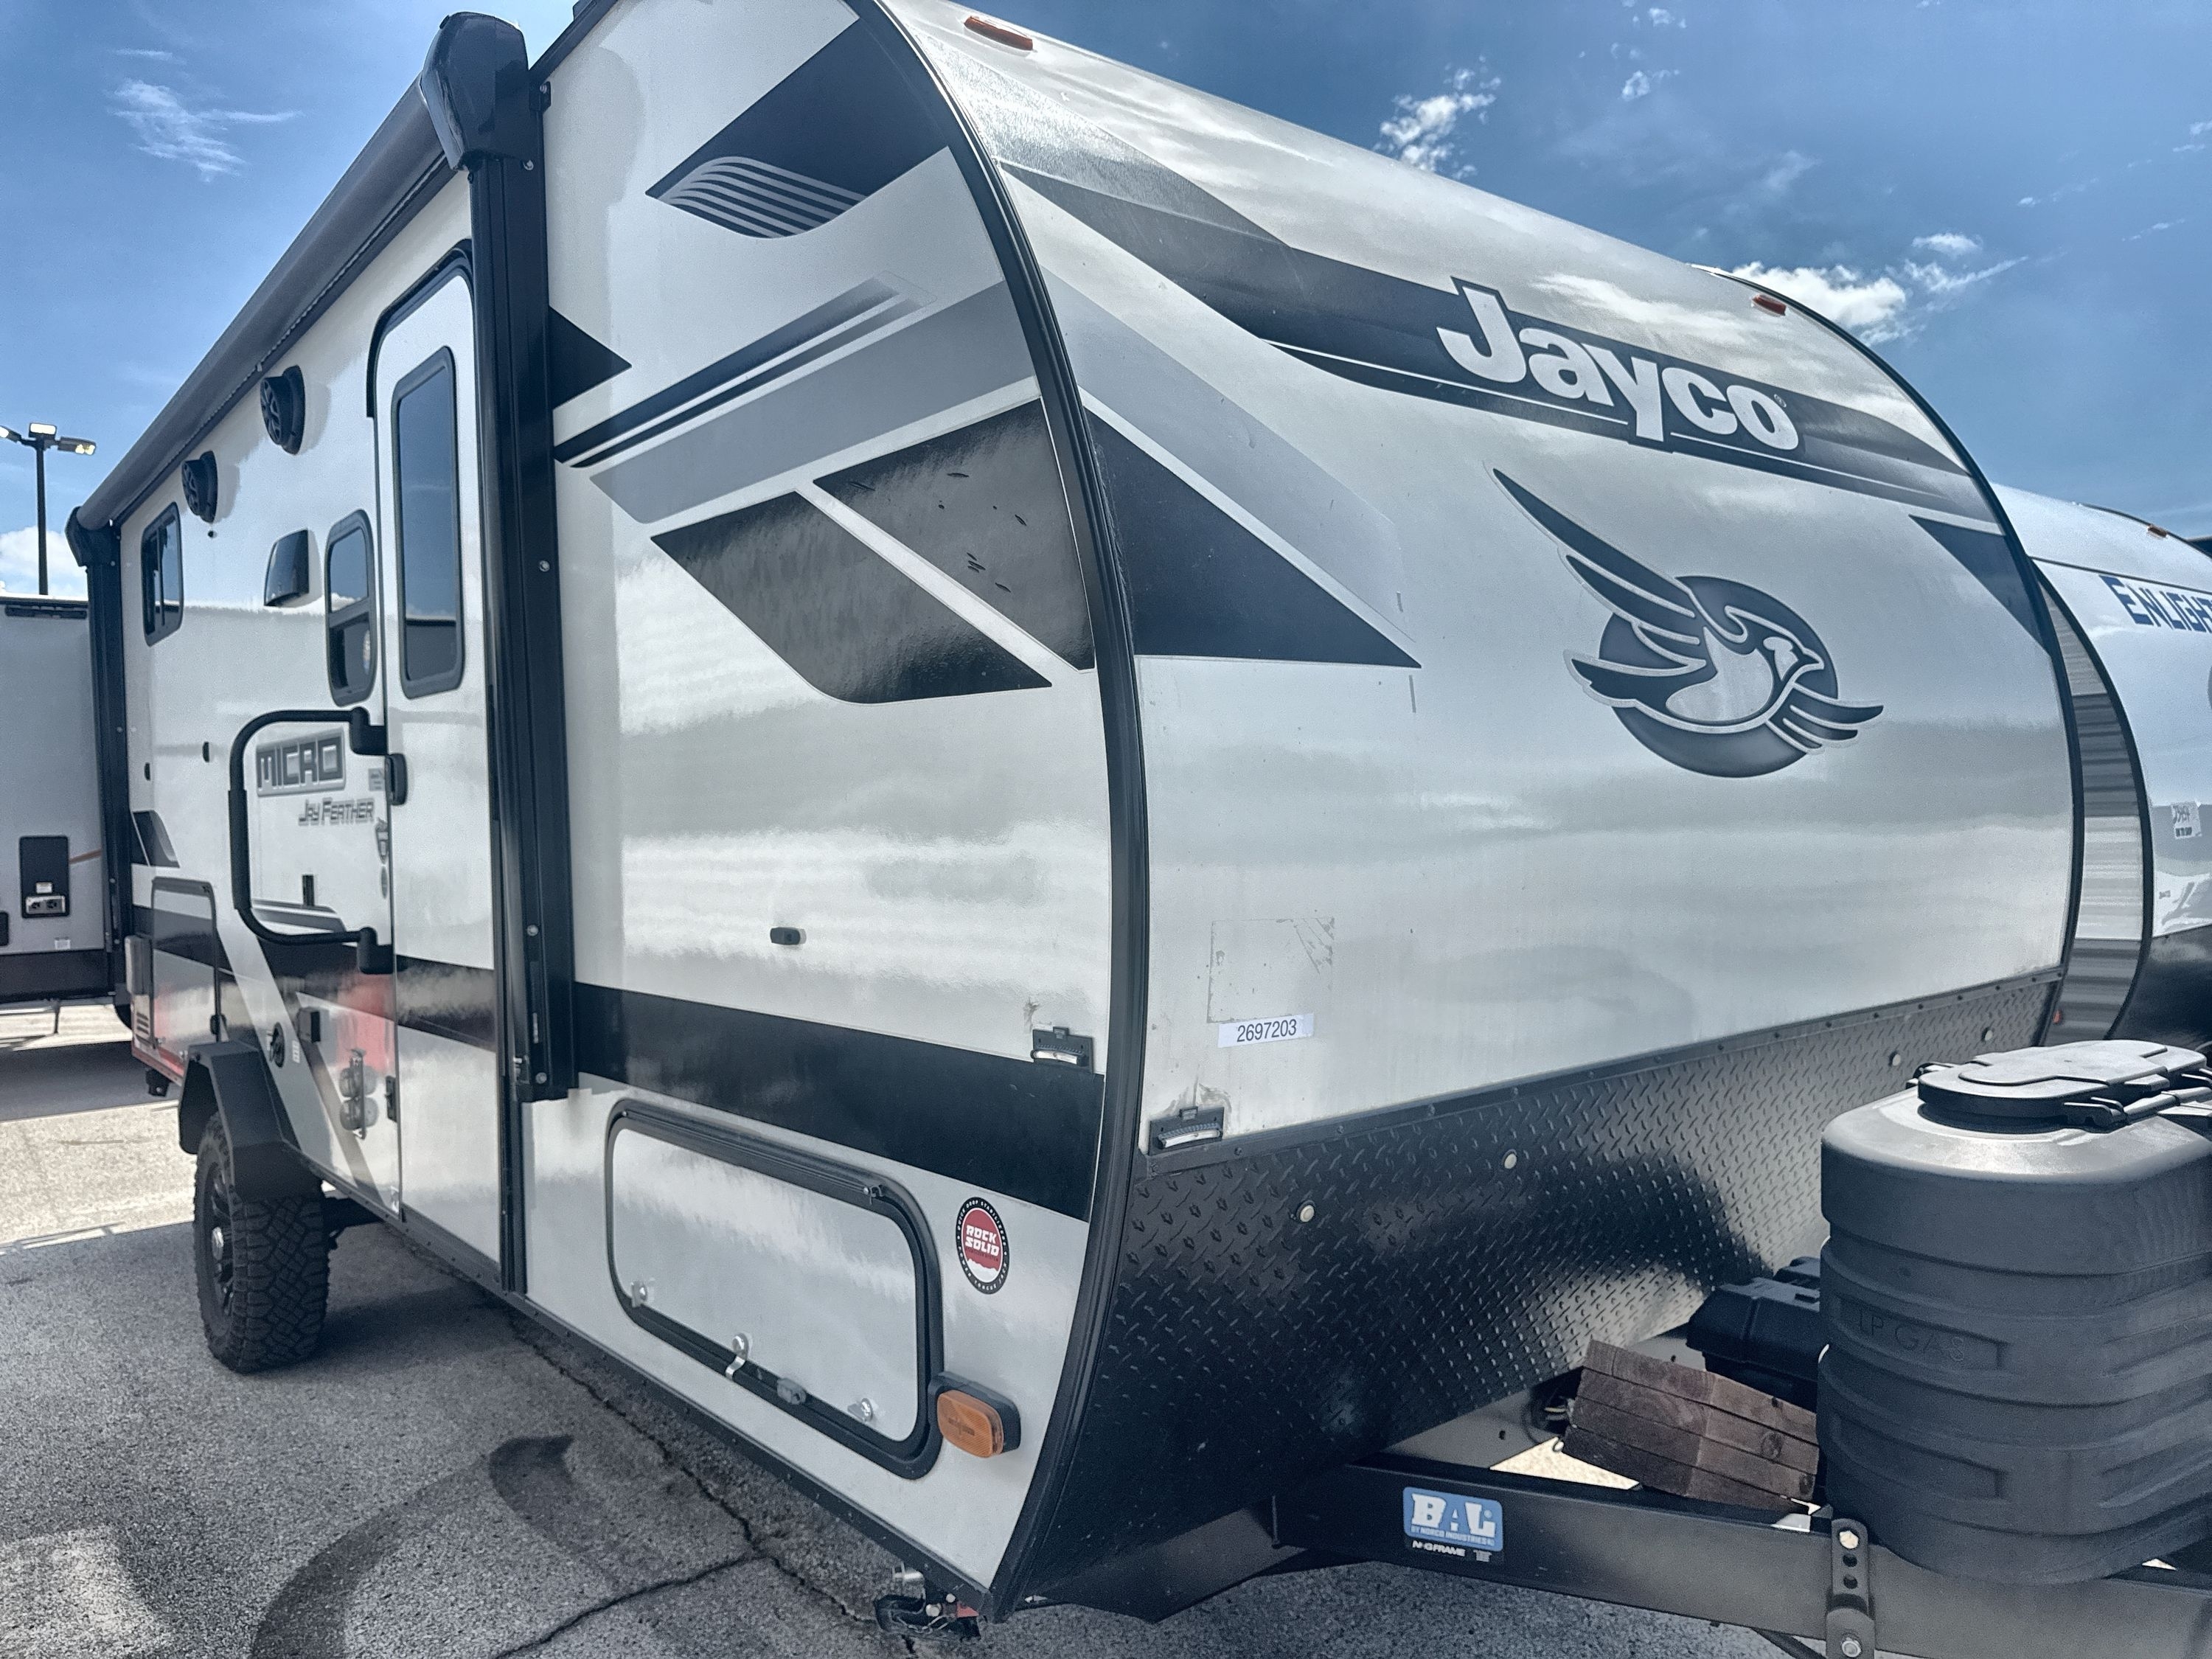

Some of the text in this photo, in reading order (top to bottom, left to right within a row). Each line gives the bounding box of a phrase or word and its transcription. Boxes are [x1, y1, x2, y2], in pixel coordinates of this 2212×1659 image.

[1436, 285, 1799, 451] Jayco
[257, 736, 344, 790] MICRO
[1237, 1019, 1297, 1043] 2697203
[965, 1236, 1000, 1256] SOLID
[966, 1225, 997, 1244] ROCK
[1411, 1493, 1496, 1538] BAL
